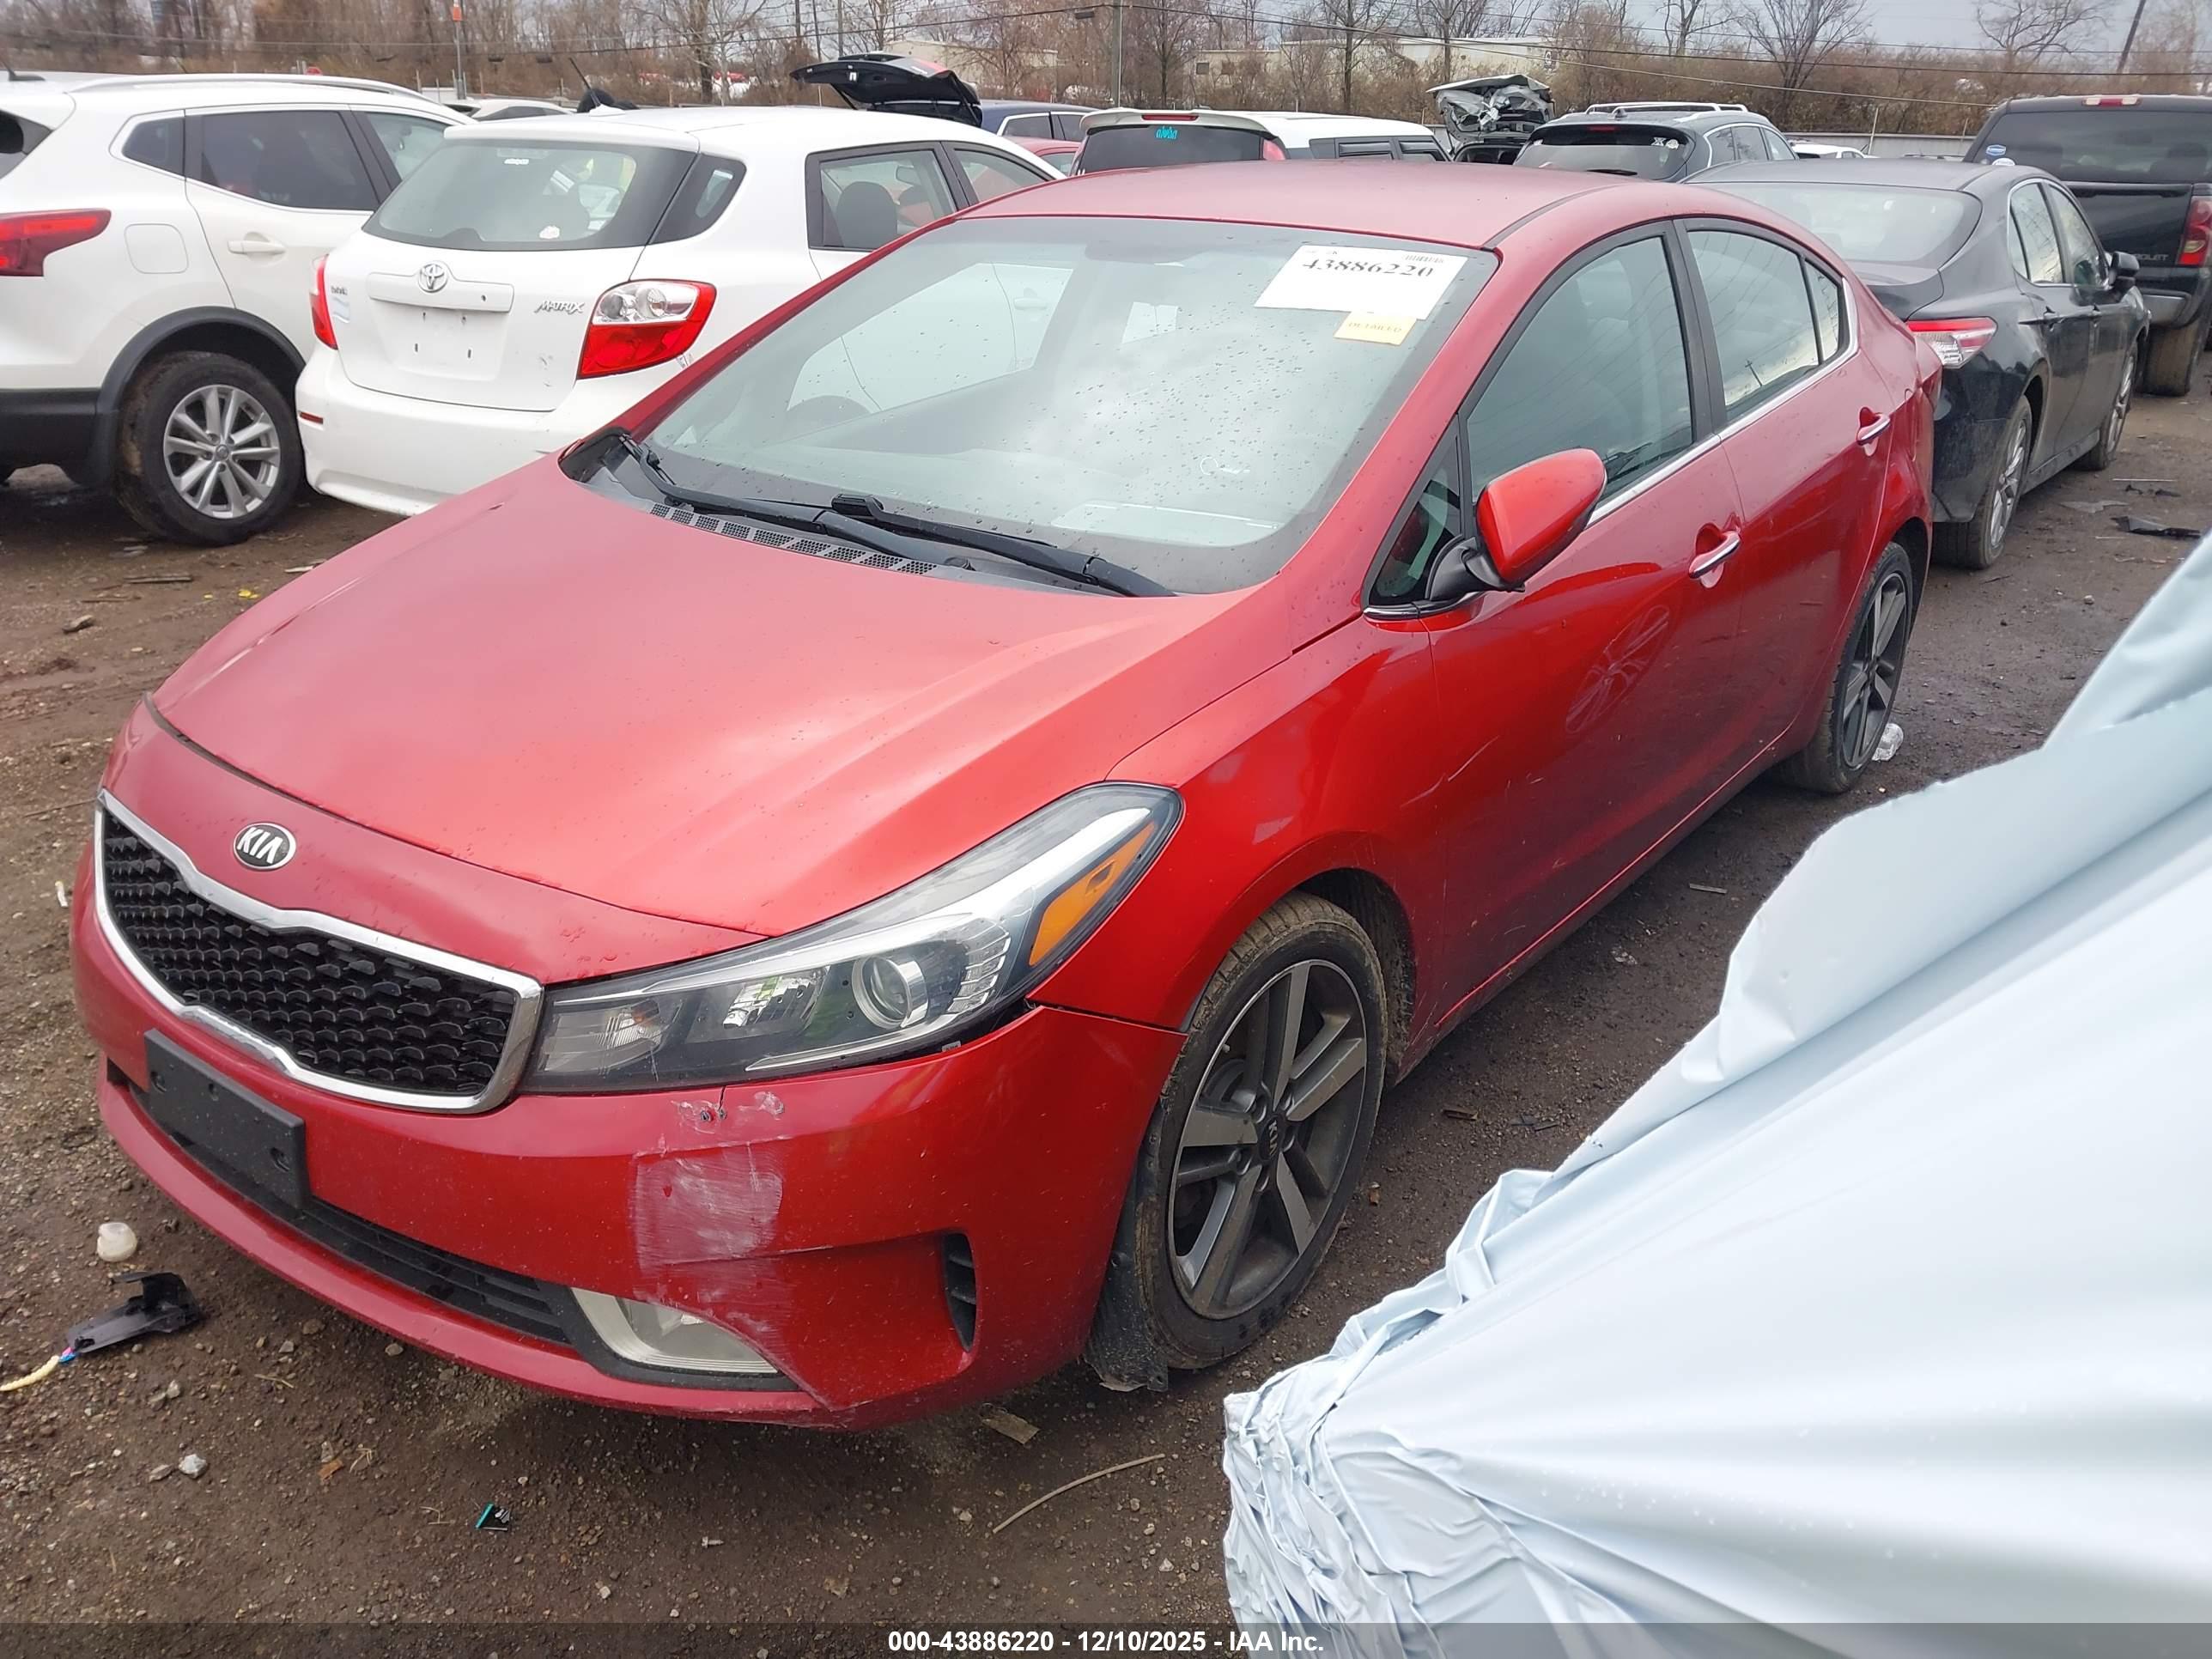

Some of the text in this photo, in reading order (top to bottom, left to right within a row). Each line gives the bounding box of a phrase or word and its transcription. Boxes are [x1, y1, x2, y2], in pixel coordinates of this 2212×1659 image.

[1303, 258, 1434, 276] 43886220
[533, 300, 586, 315] MATRIX
[236, 826, 283, 865] KIA
[1268, 1120, 1279, 1157] KIA
